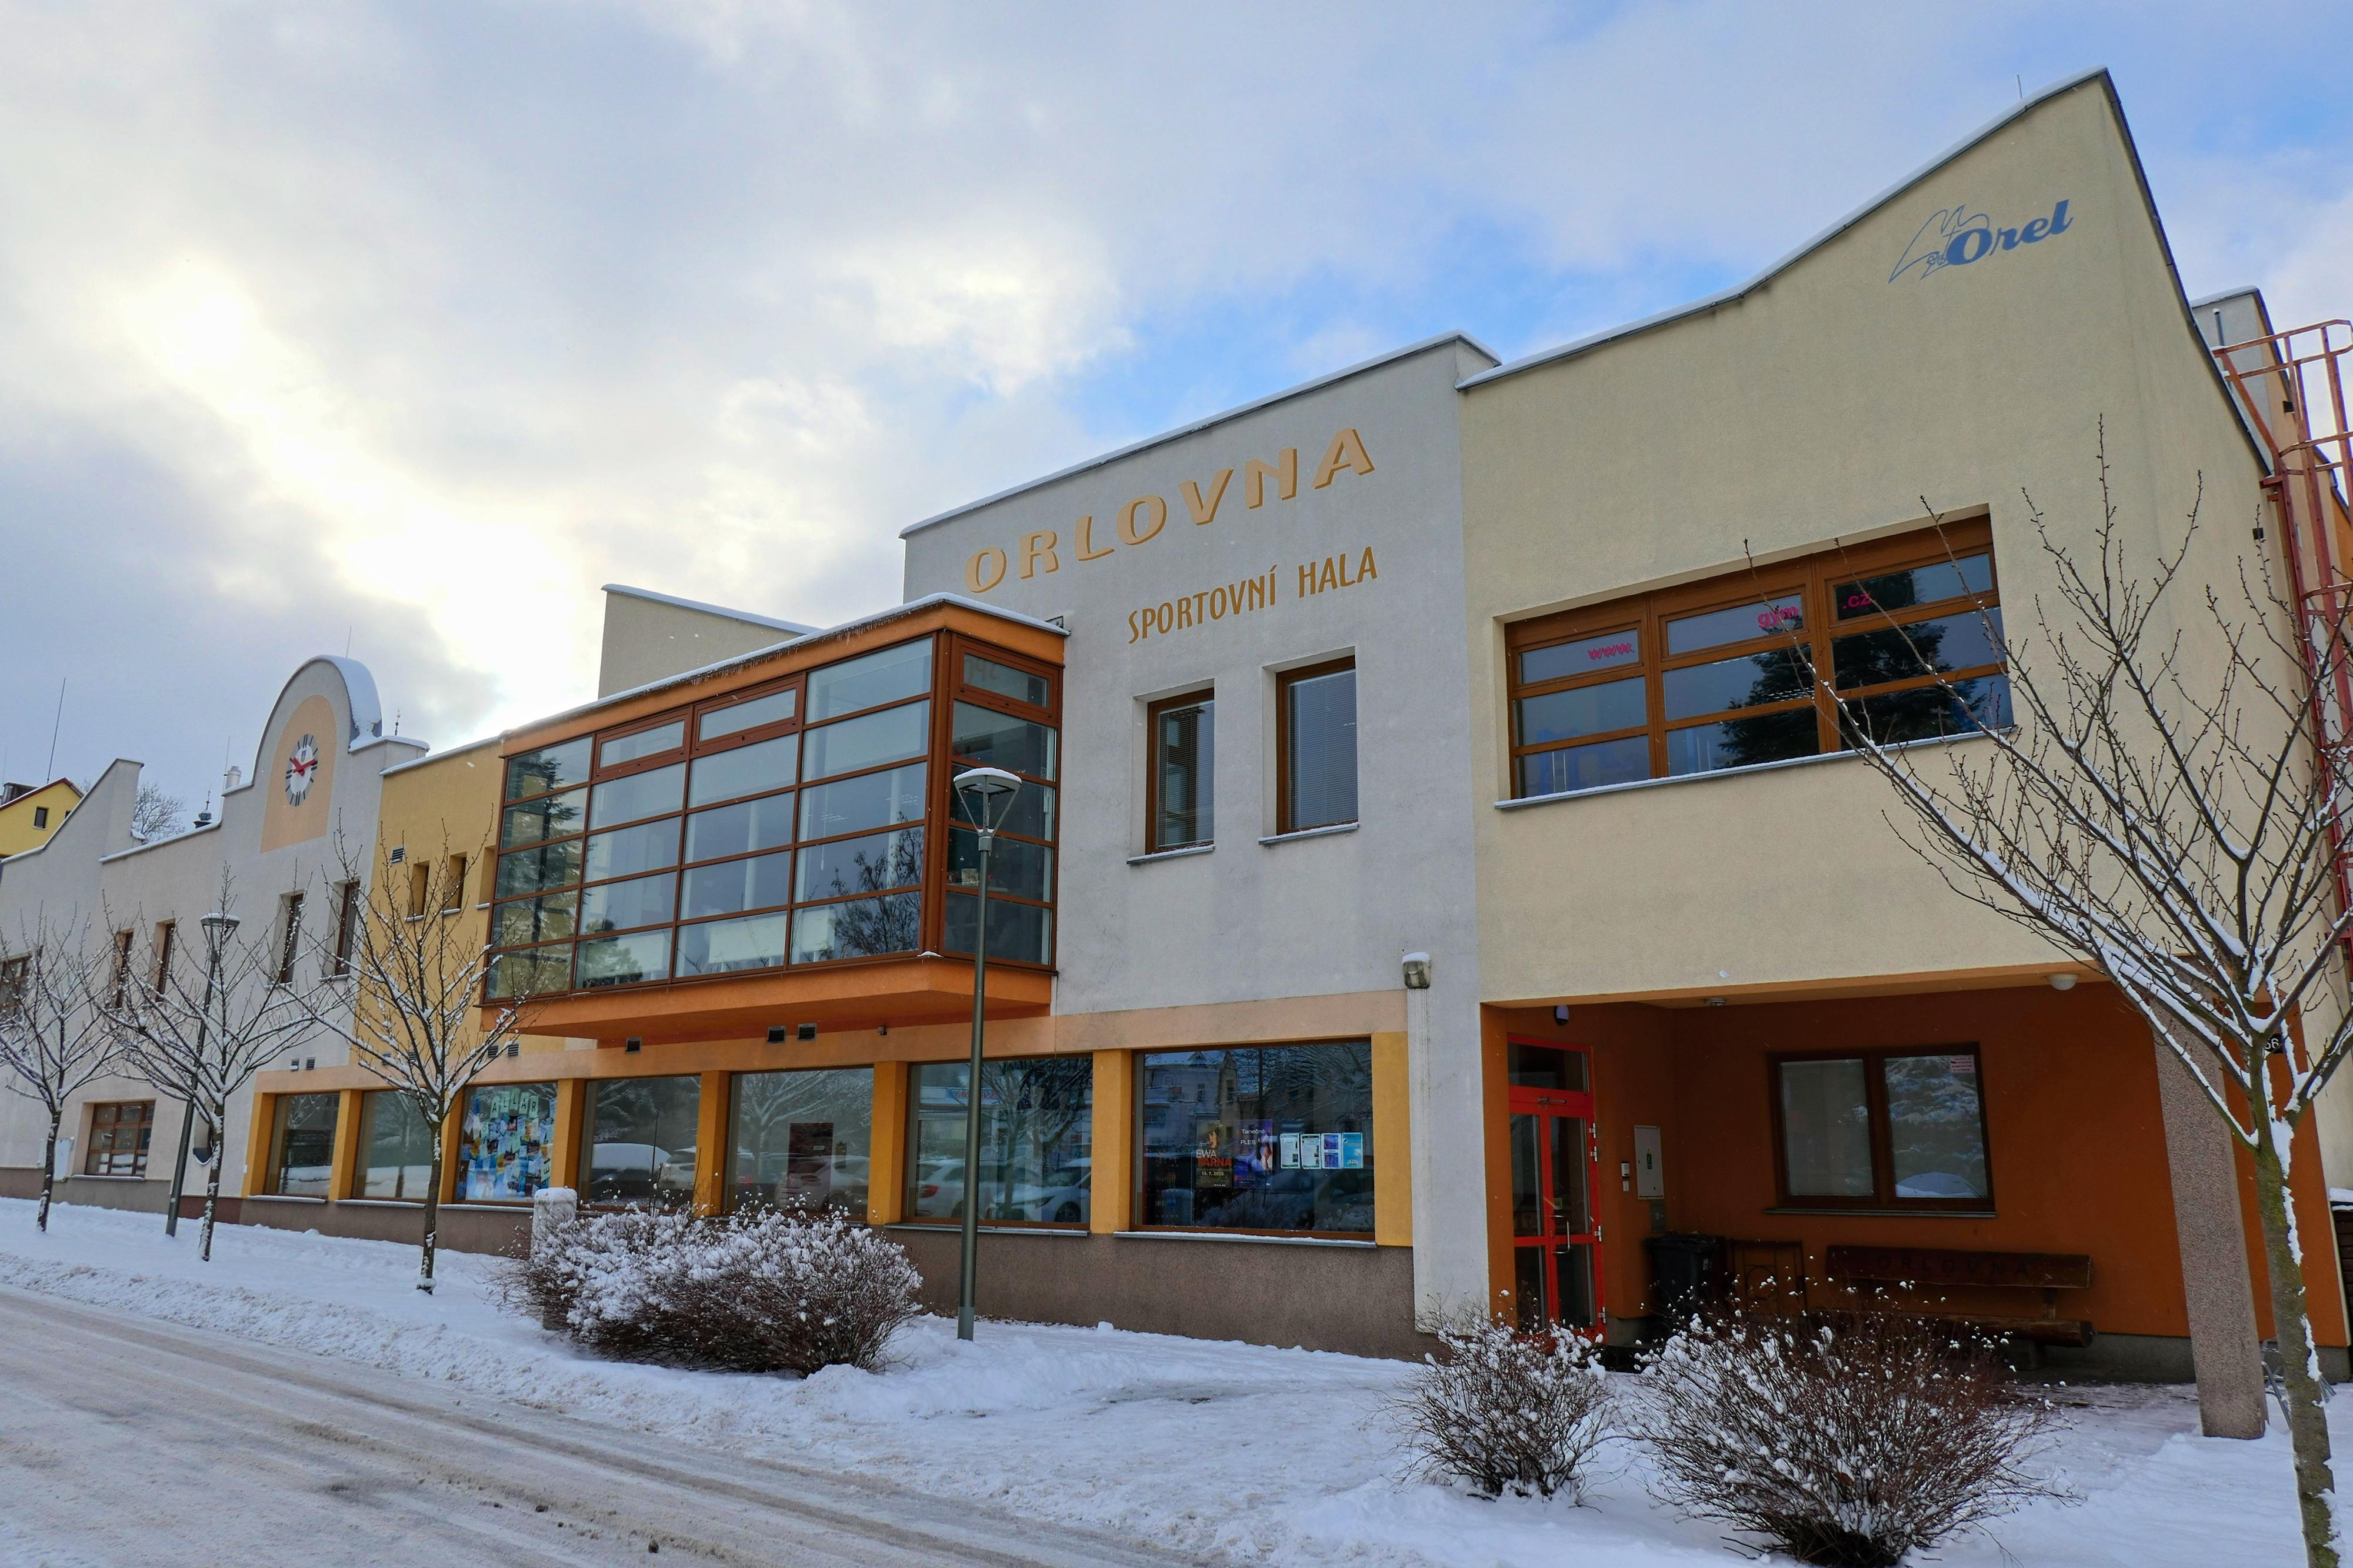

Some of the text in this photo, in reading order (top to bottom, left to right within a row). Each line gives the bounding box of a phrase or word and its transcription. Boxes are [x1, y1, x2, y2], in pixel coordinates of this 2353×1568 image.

[1946, 199, 2074, 265] Orel
[964, 428, 1375, 593] ORLOVNA
[1128, 546, 1378, 643] SPORTOVNÍ HALA
[1758, 606, 1798, 629] gym
[1196, 1149, 1217, 1158] EWA
[1877, 1256, 2029, 1276] ORLOVNA
